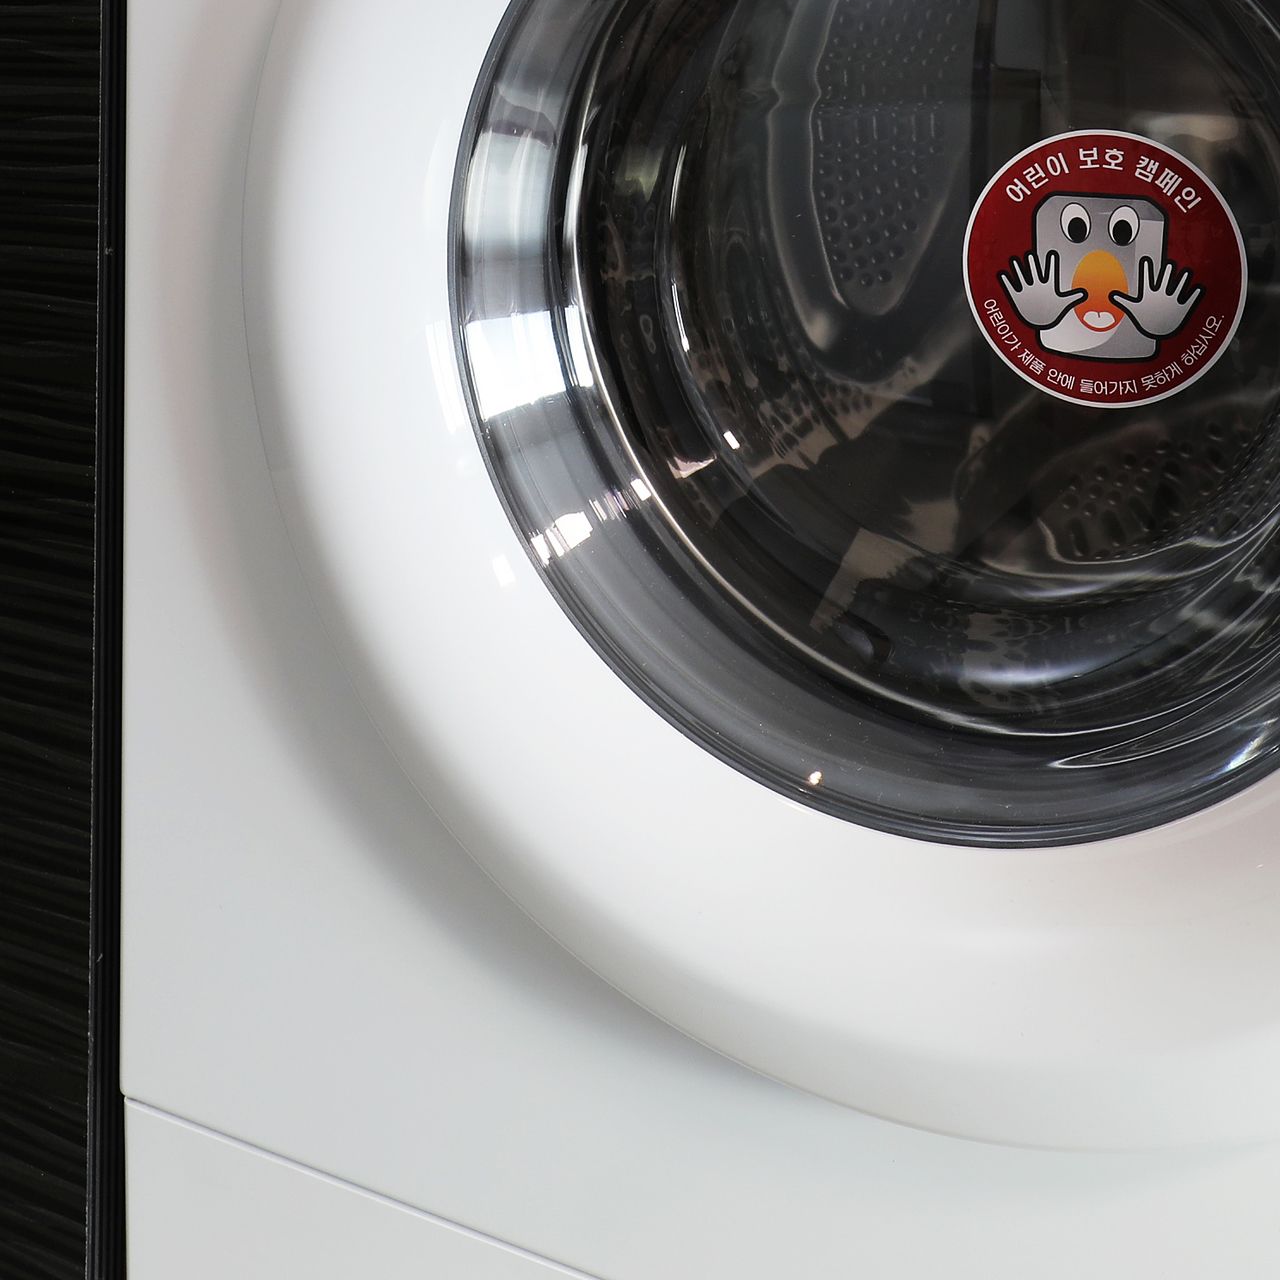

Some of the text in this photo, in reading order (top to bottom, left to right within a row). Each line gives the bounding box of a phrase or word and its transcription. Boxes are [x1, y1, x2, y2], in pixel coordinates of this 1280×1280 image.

[1005, 147, 1202, 213] 어린이 보호 캠페인
[983, 298, 1226, 395] 어린이가 제품 안에 들어가지 못하게 하십시오.
